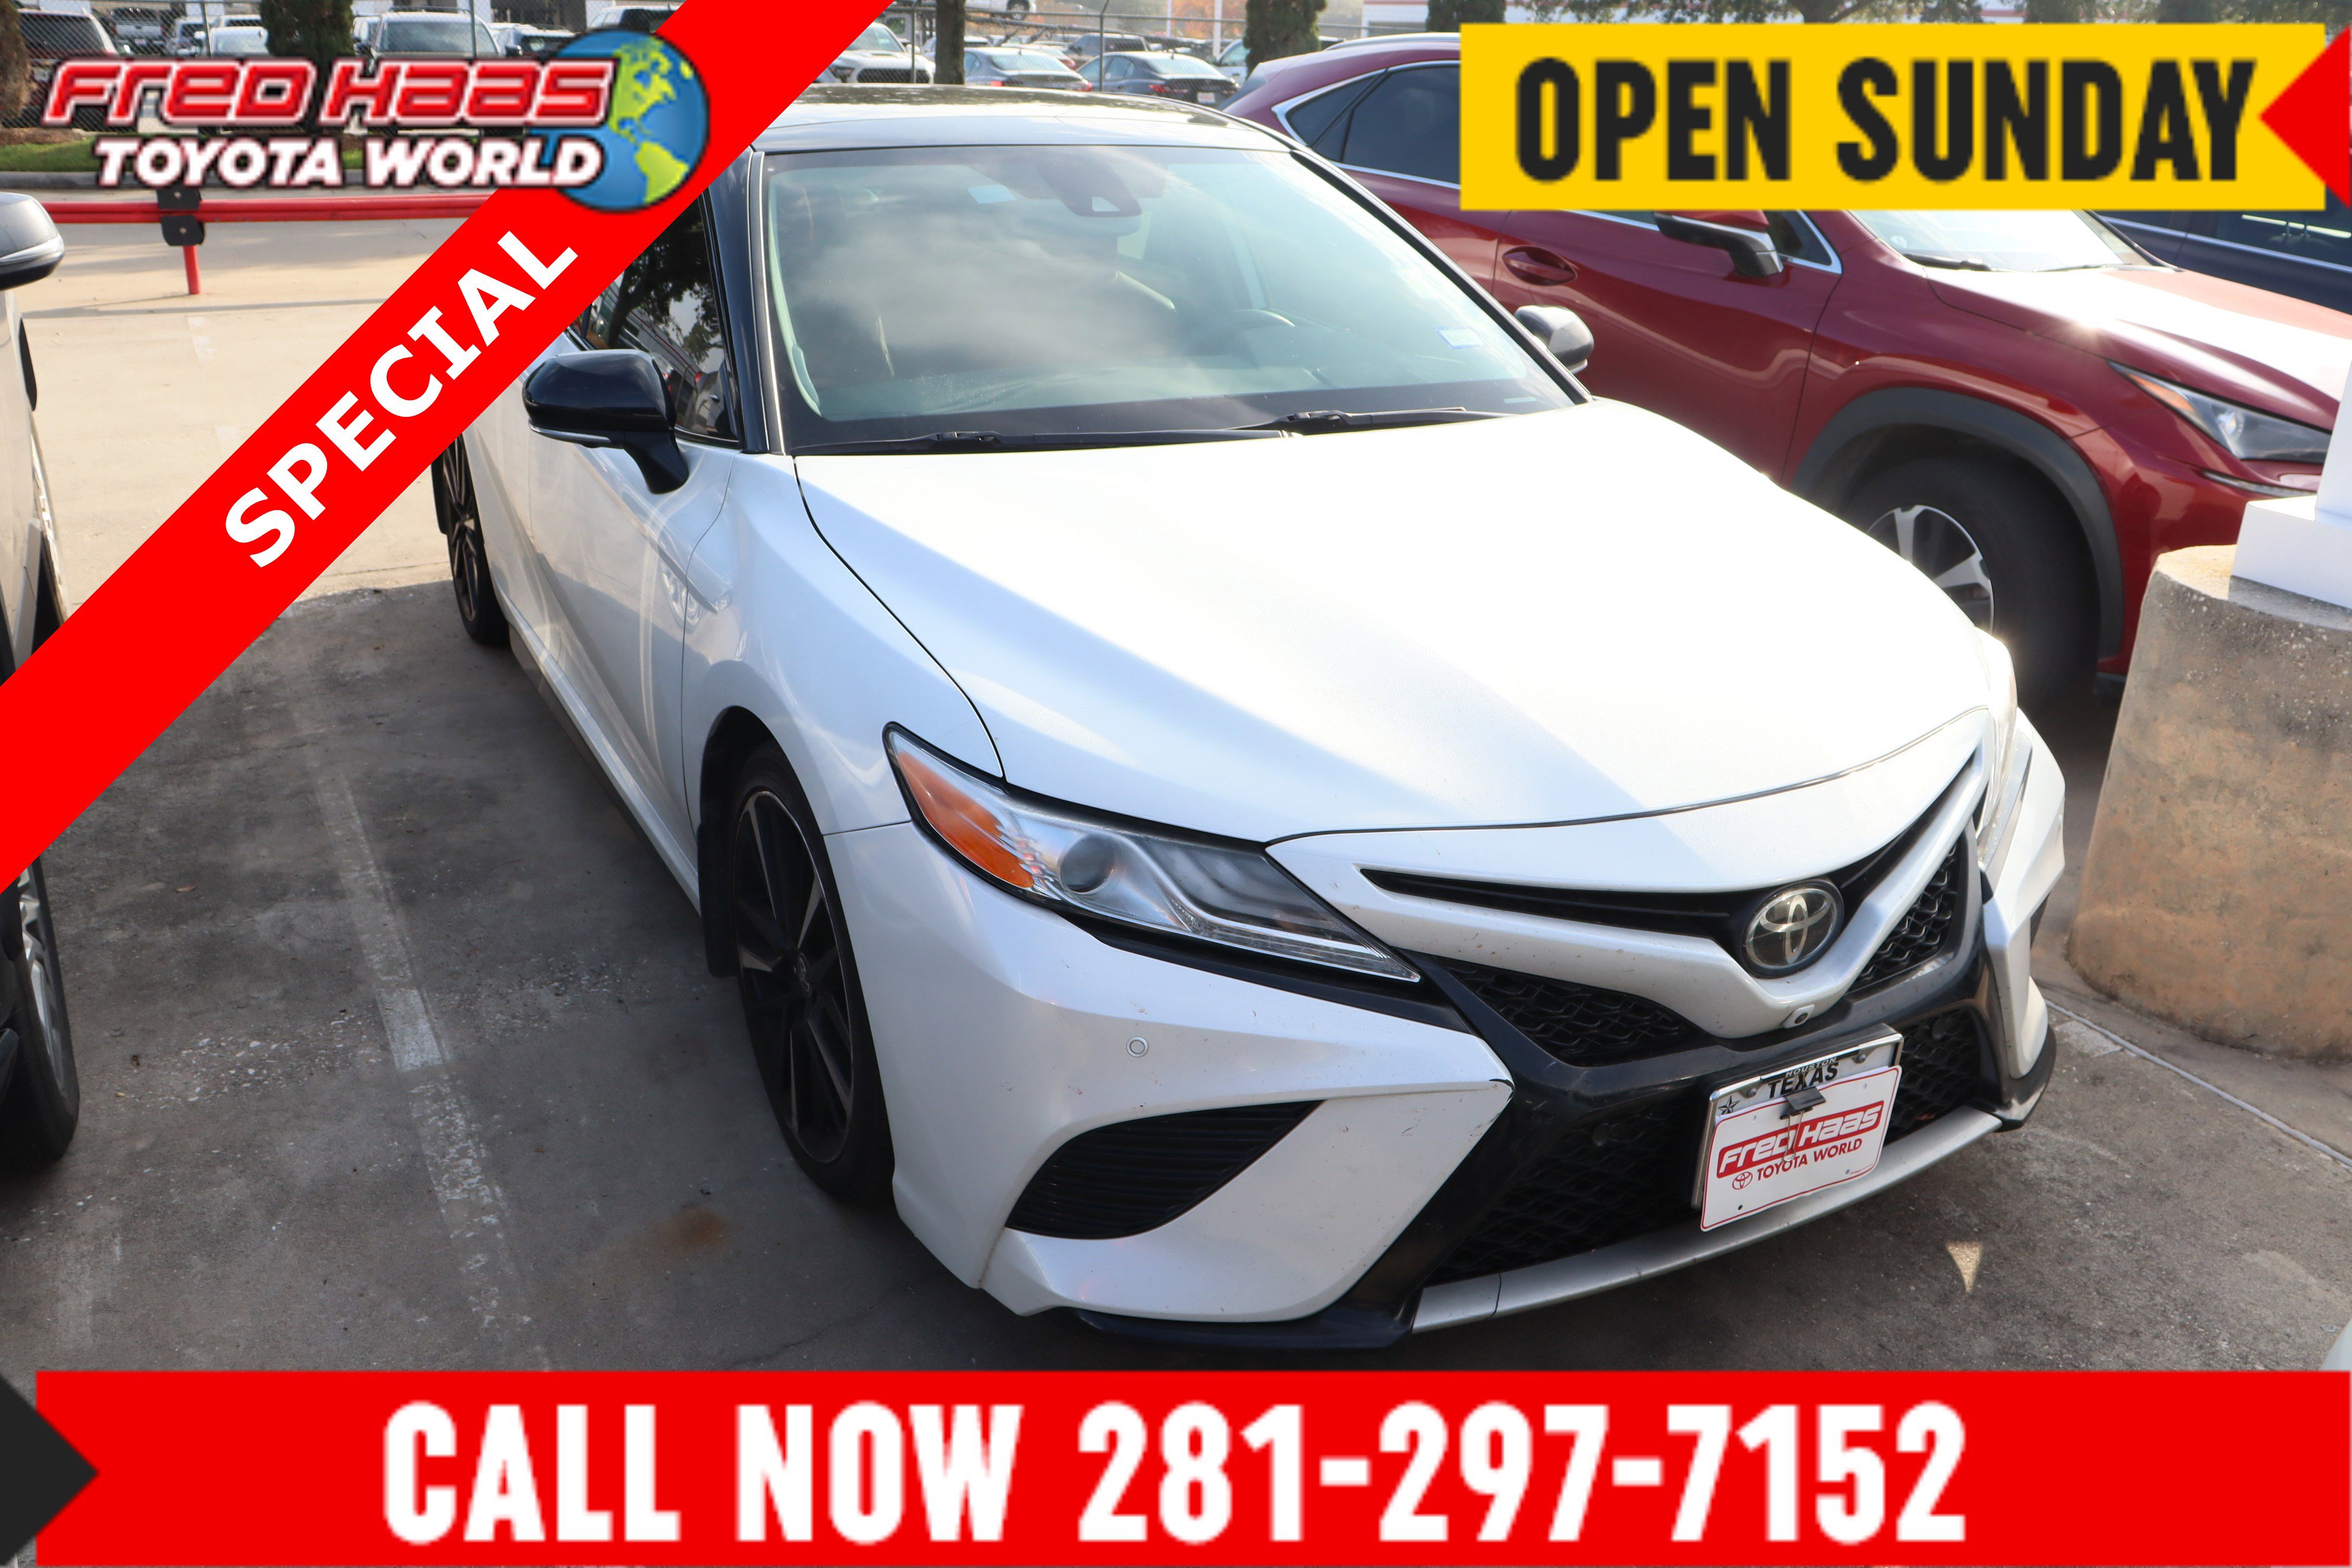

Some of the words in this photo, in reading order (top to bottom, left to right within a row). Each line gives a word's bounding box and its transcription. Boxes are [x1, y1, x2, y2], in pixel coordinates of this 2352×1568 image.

[1768, 1062, 1840, 1098] TEXAS
[1785, 1057, 1838, 1077] HOUSTON
[1757, 1154, 1808, 1181] TOYOTA
[1814, 1138, 1863, 1162] WORLD
